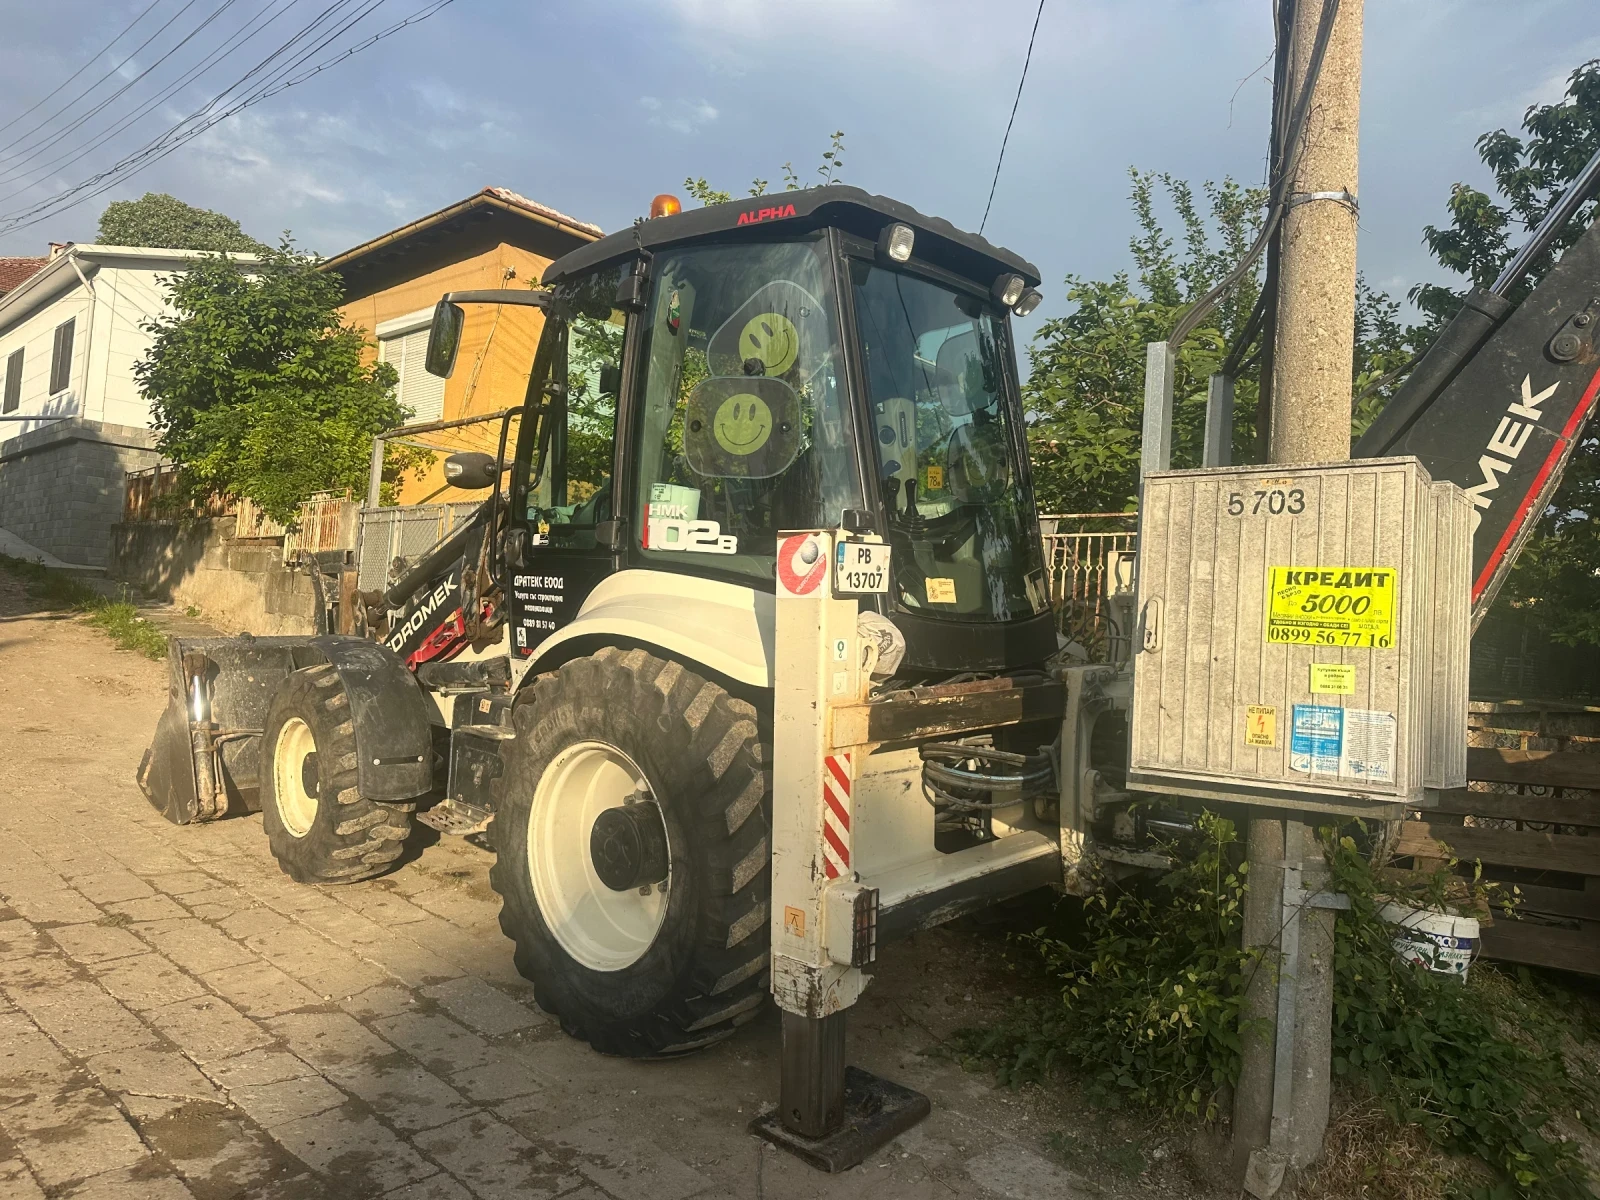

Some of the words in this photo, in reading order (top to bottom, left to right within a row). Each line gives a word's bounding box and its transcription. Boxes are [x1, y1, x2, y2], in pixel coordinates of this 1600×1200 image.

[737, 204, 796, 226] ALPHA
[1463, 373, 1560, 537] MEK
[649, 503, 688, 518] HMK
[1228, 488, 1306, 516] 5703
[648, 518, 738, 555] 102B
[858, 548, 872, 564] PB
[514, 575, 543, 588] ДРАТЕКС
[544, 576, 564, 590] ЕООД
[846, 572, 883, 589] 13707
[1286, 571, 1390, 588] КРЕДИТ
[1301, 593, 1371, 616] 5000
[1270, 627, 1311, 643] 0899
[1316, 630, 1336, 645] 56
[1341, 632, 1362, 646] 77
[1369, 633, 1389, 648] 16
